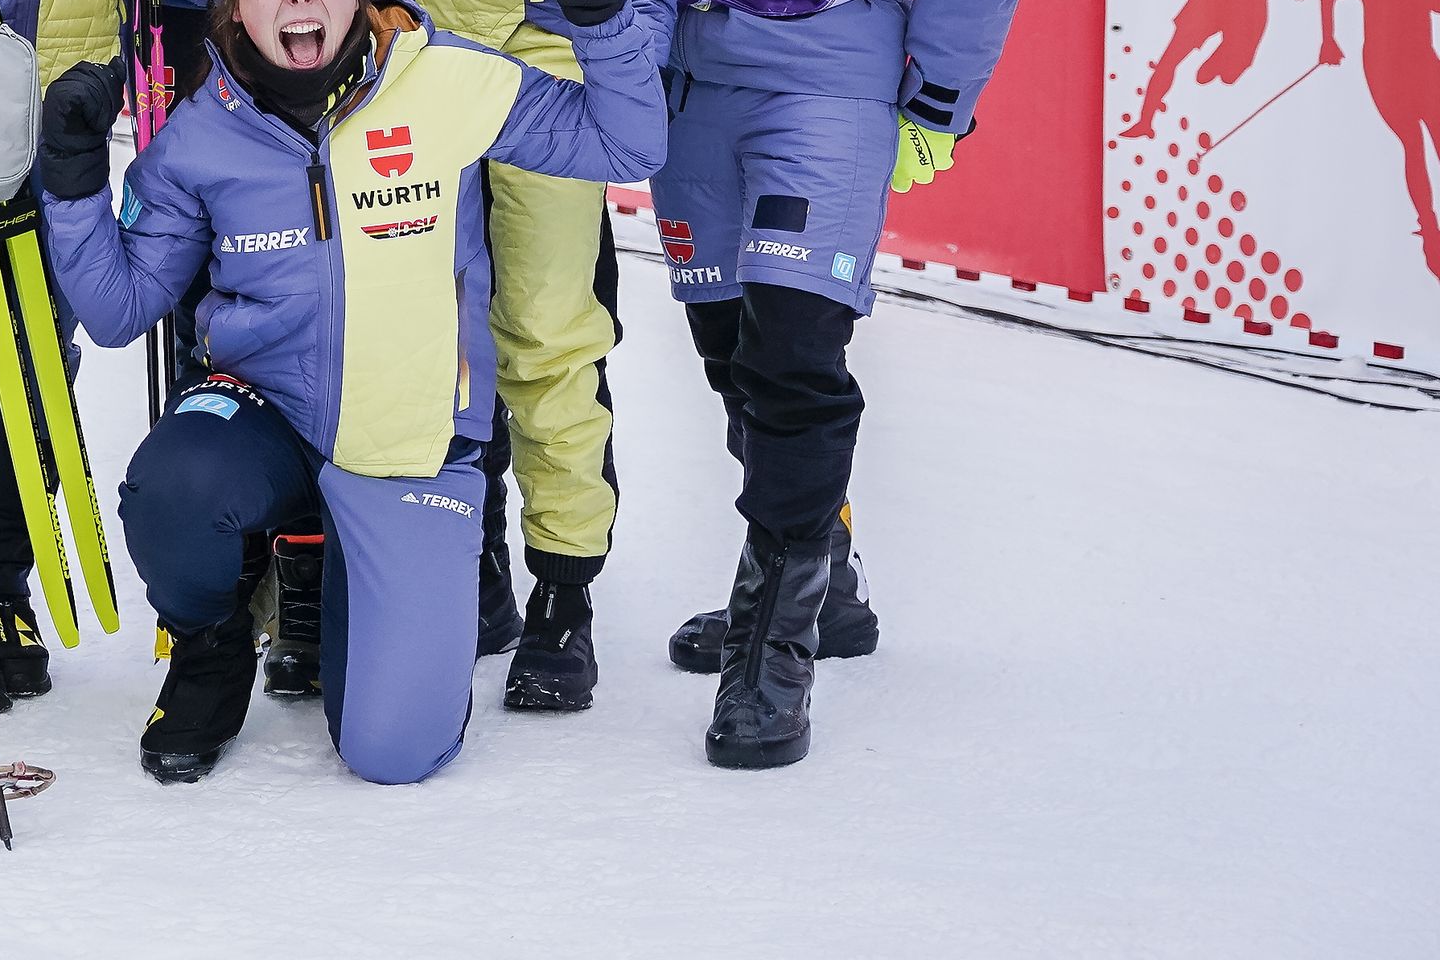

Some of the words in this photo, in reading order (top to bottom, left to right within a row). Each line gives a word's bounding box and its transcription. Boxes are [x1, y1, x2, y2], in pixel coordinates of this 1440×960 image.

[907, 128, 931, 166] Roeckl
[351, 180, 442, 211] WÜRTH
[397, 214, 439, 237] DSV
[235, 227, 311, 253] TERREX
[756, 240, 813, 262] TERREX
[421, 493, 475, 519] TERREX
